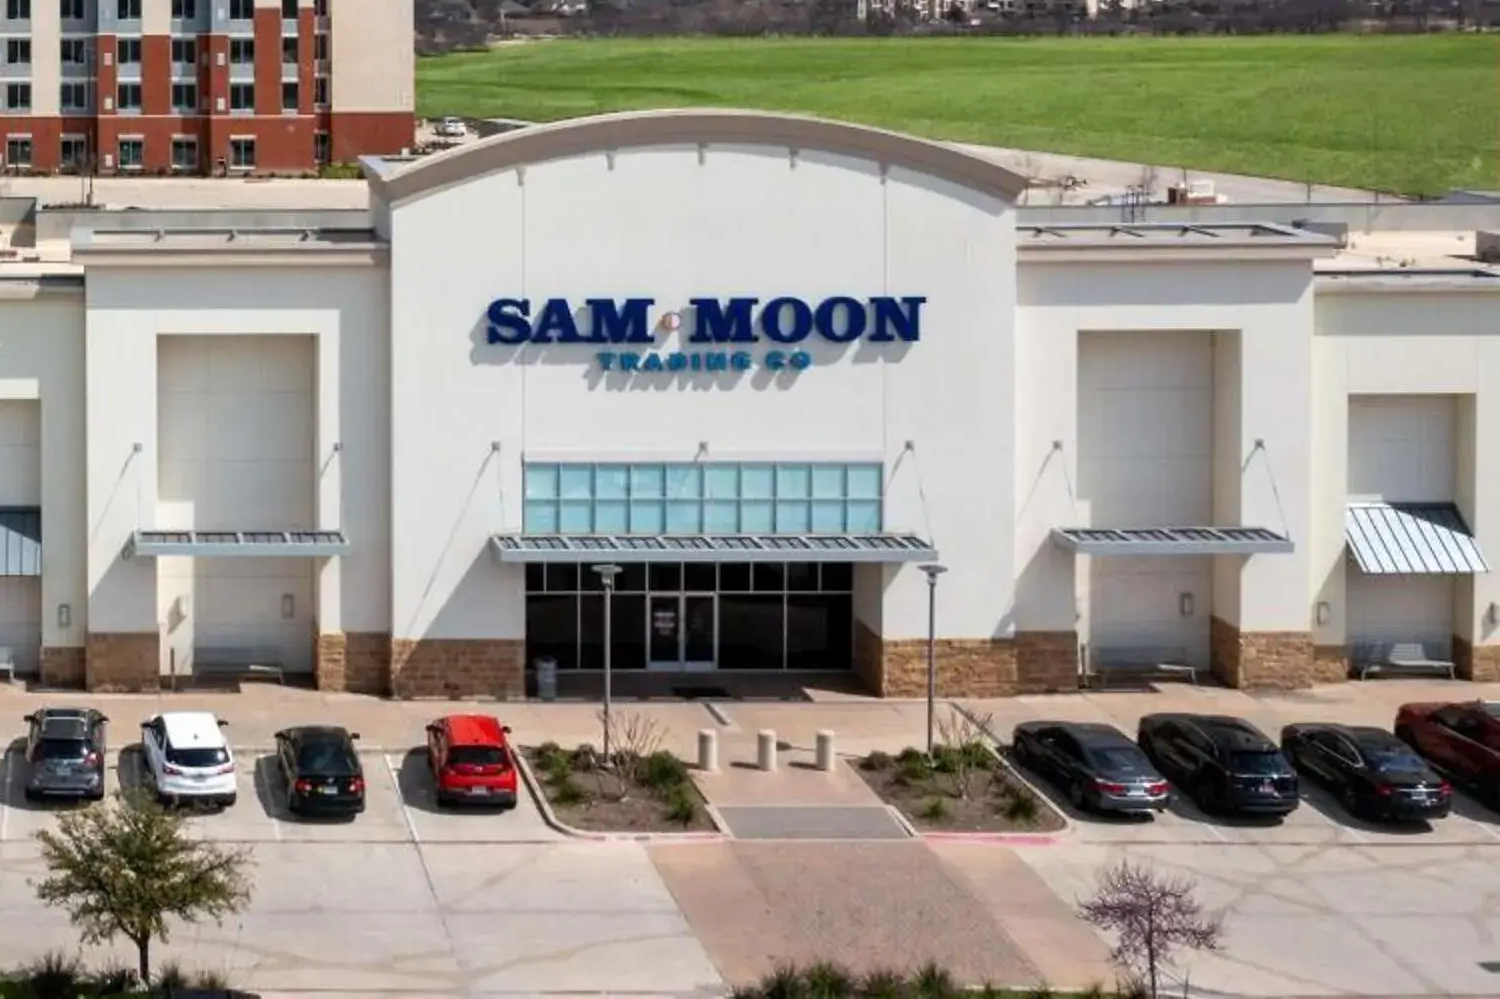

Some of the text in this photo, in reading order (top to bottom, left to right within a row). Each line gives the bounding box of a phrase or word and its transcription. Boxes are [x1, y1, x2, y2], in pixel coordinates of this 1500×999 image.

[486, 296, 927, 345] SAM MOON
[595, 351, 811, 372] TRADING CO
